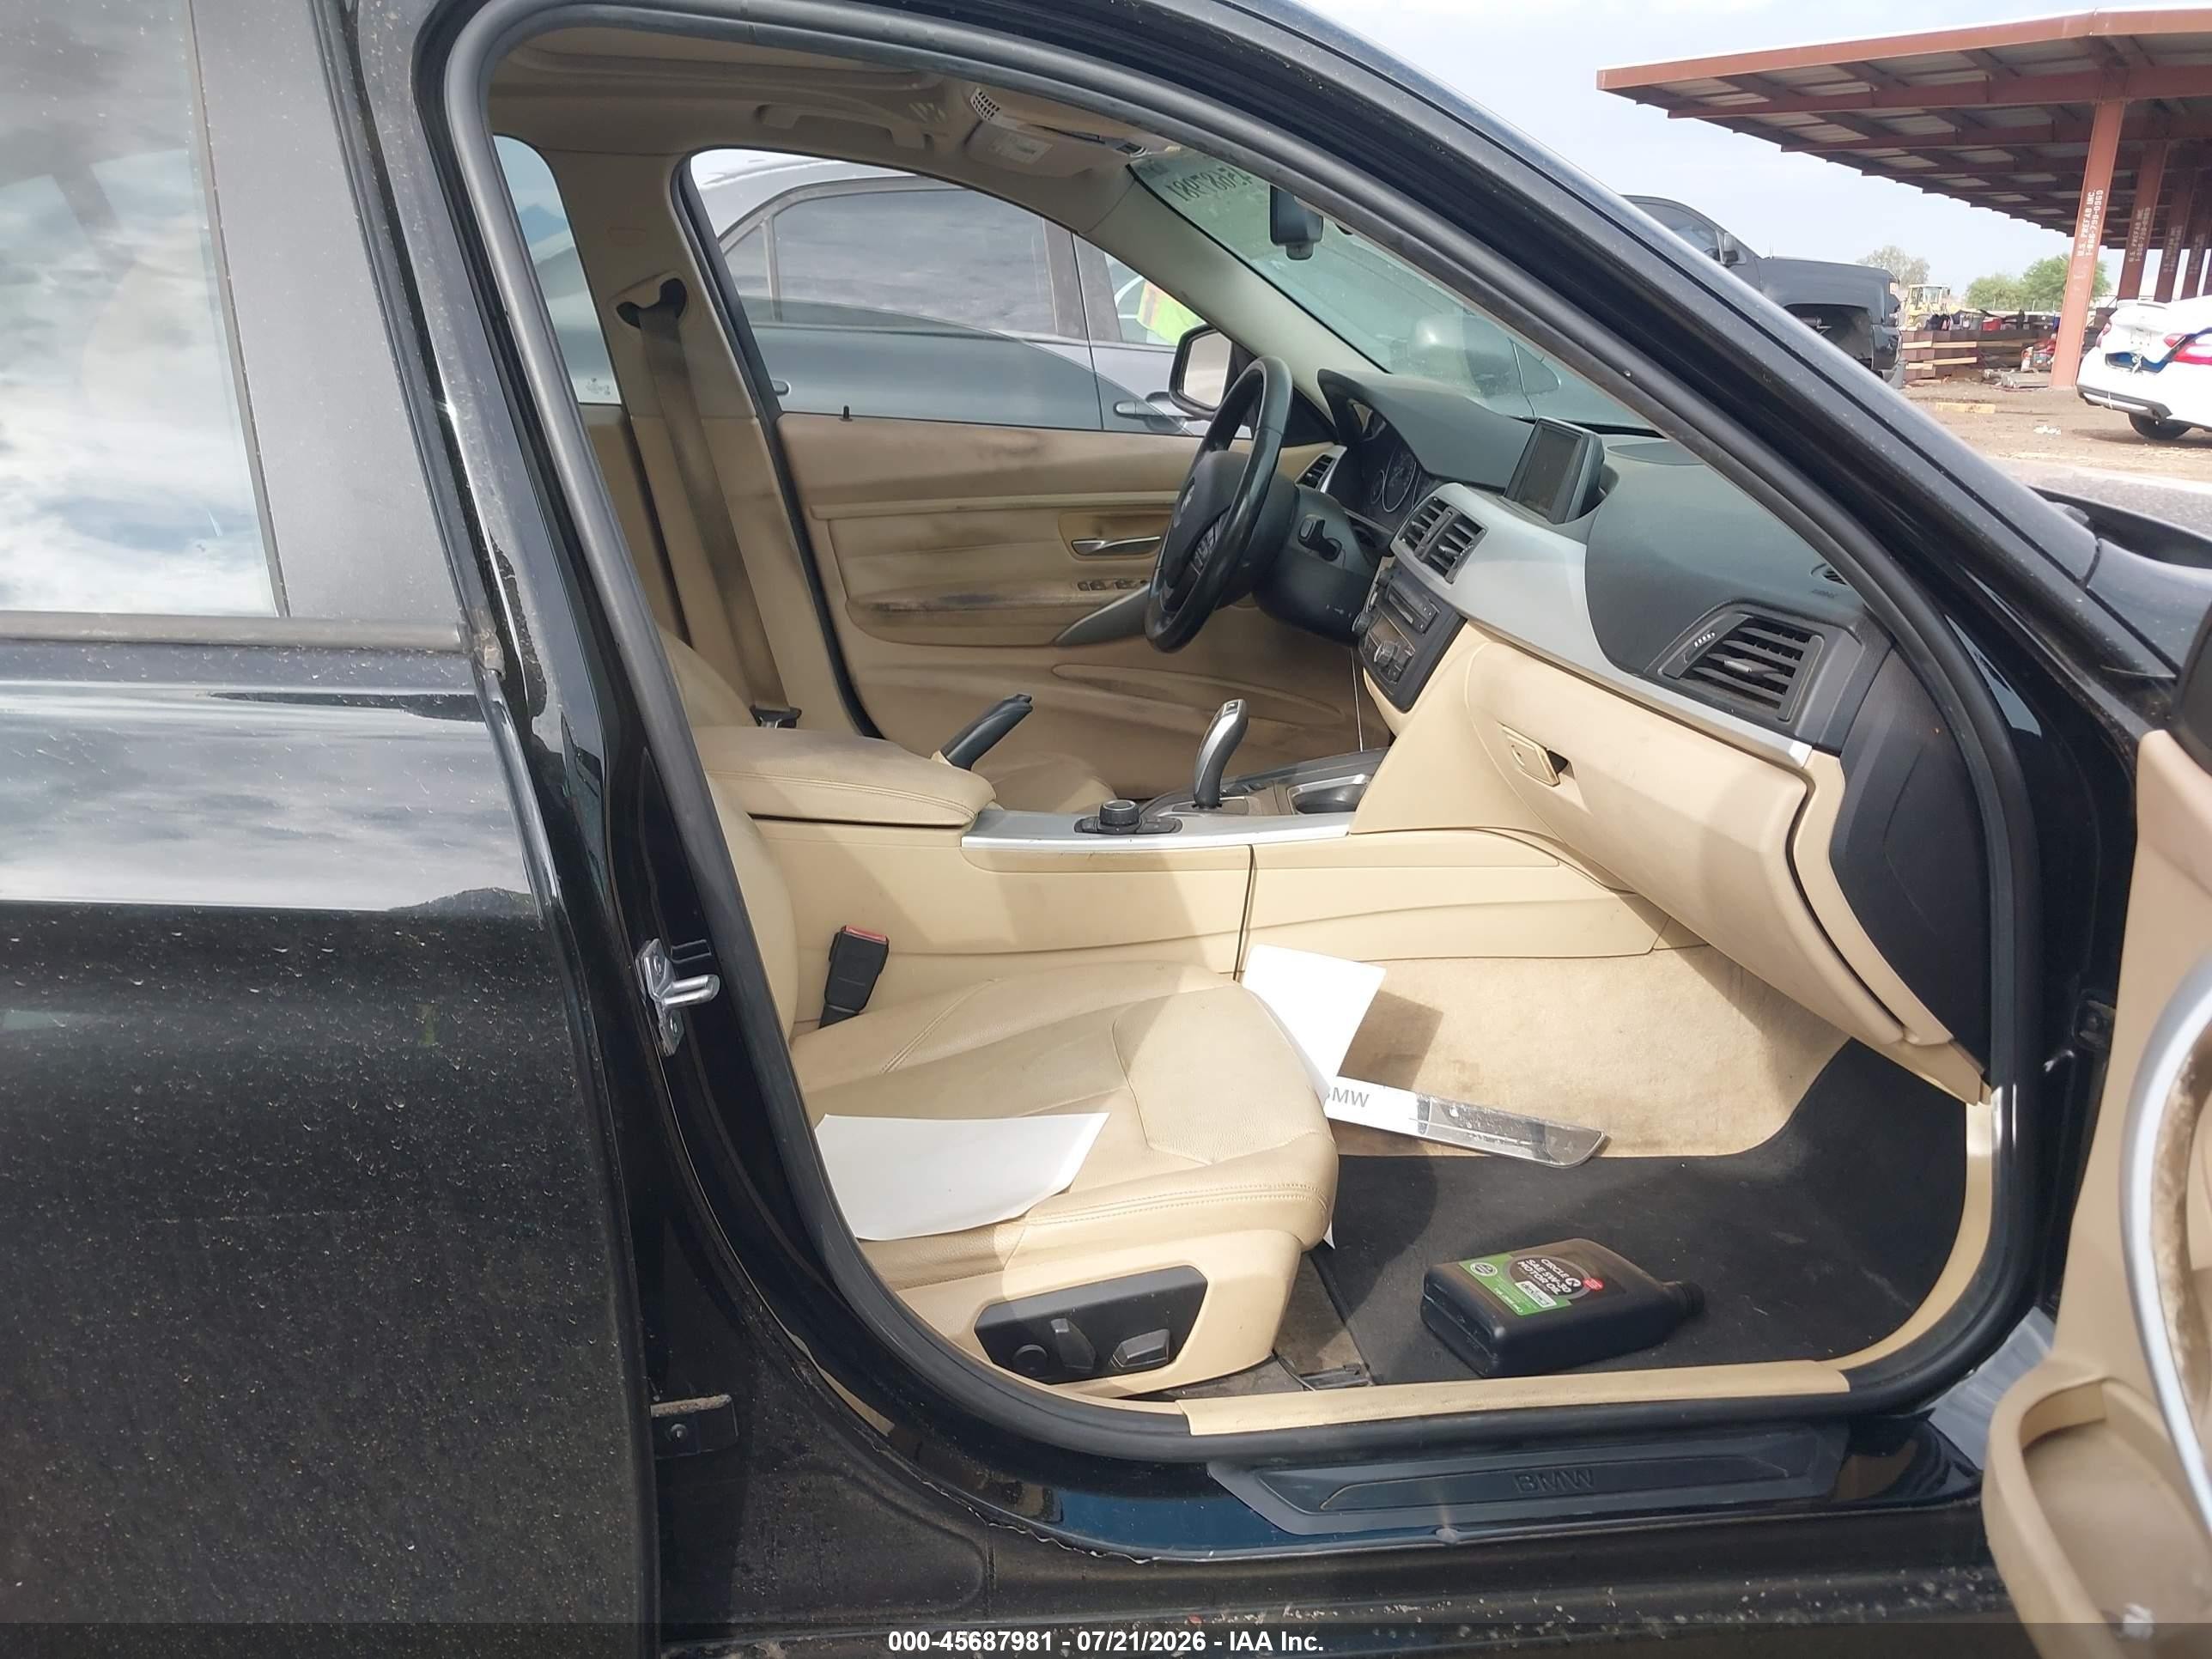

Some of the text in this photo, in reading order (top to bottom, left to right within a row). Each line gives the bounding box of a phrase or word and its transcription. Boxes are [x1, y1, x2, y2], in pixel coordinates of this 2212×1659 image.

[2080, 208, 2093, 238] PREFAB
[1517, 1261, 1549, 1284] MOTOR
[1546, 1283, 1561, 1296] OIL
[1525, 1259, 1547, 1273] SAE
[1542, 1271, 1572, 1293] 5W-30
[1540, 1258, 1570, 1279] CIRCLE
[1513, 1469, 1595, 1493] BMW
